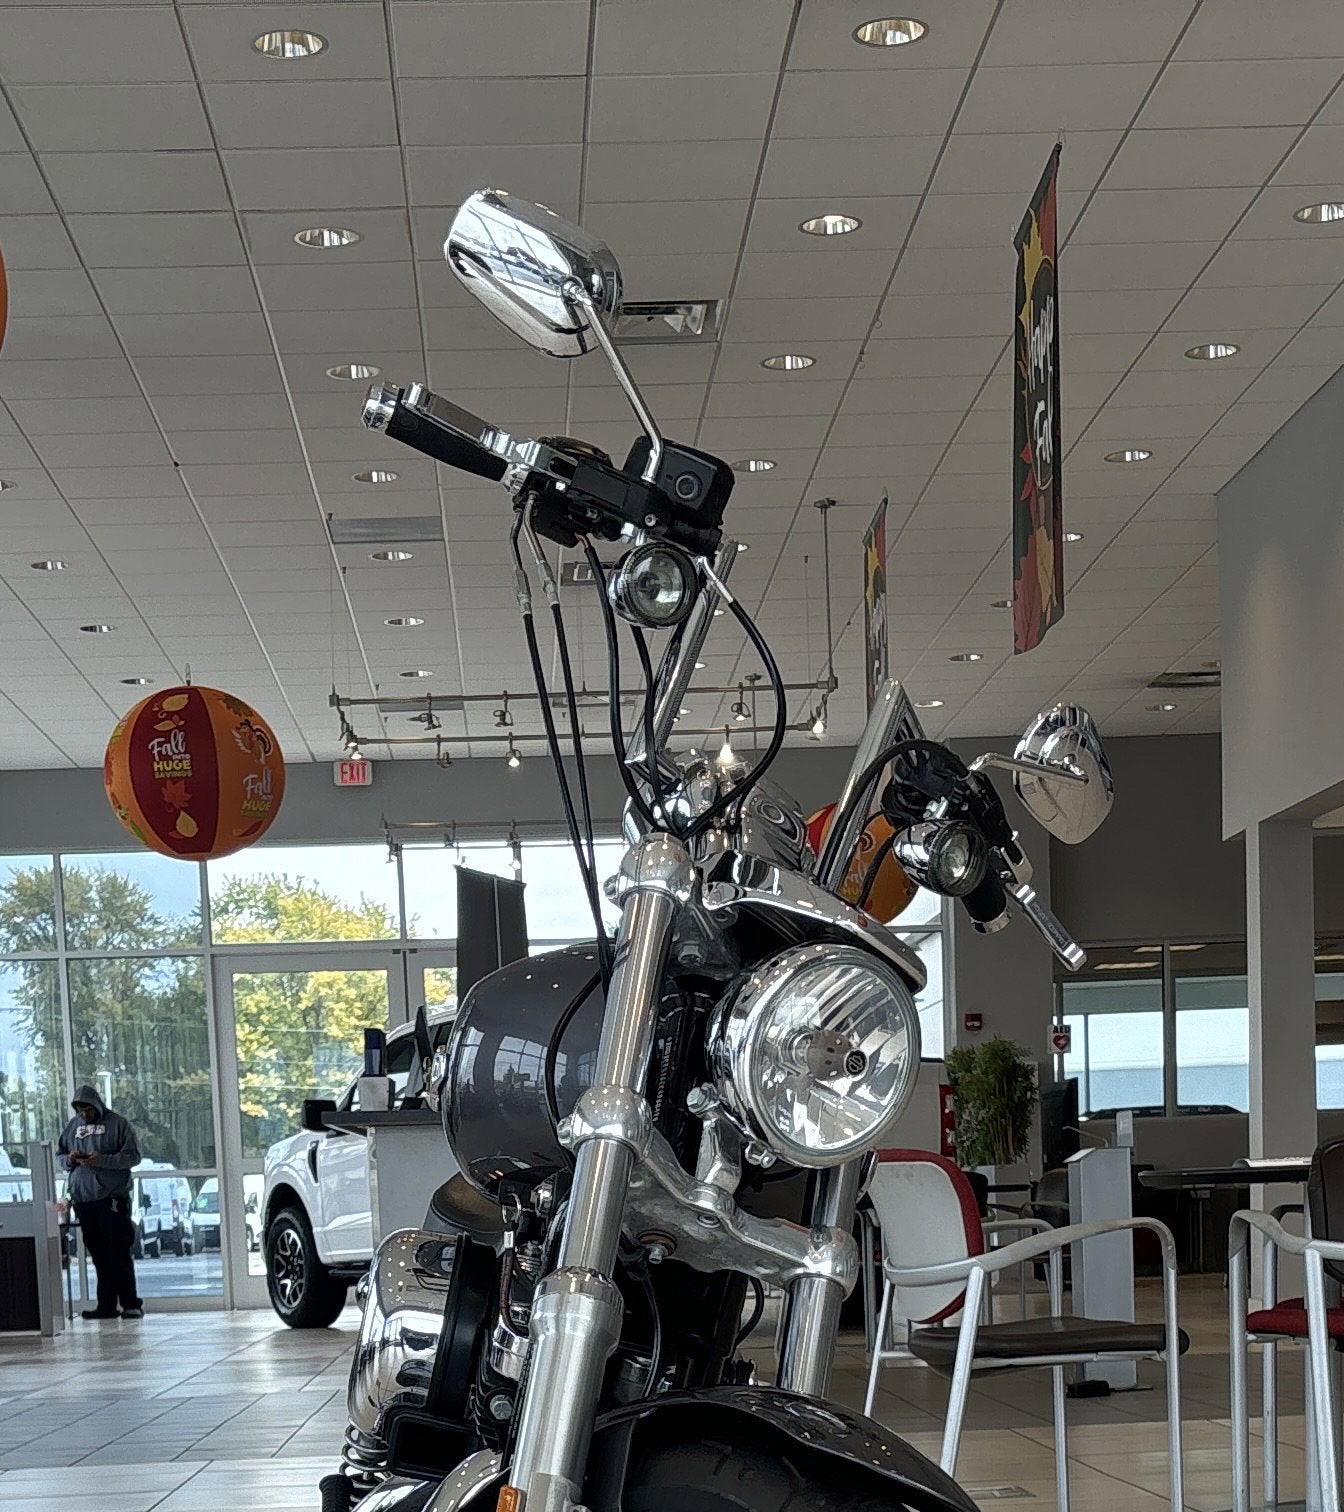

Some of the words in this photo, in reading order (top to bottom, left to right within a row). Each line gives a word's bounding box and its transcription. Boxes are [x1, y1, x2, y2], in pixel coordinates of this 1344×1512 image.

[1028, 295, 1054, 393] Happ
[148, 728, 186, 761] Fall
[153, 760, 192, 772] HUGE
[154, 770, 193, 779] SAVINGS
[339, 761, 367, 784] EXIT
[242, 766, 272, 800] Fall
[242, 800, 272, 811] HUGE
[1052, 1024, 1071, 1034] AED
